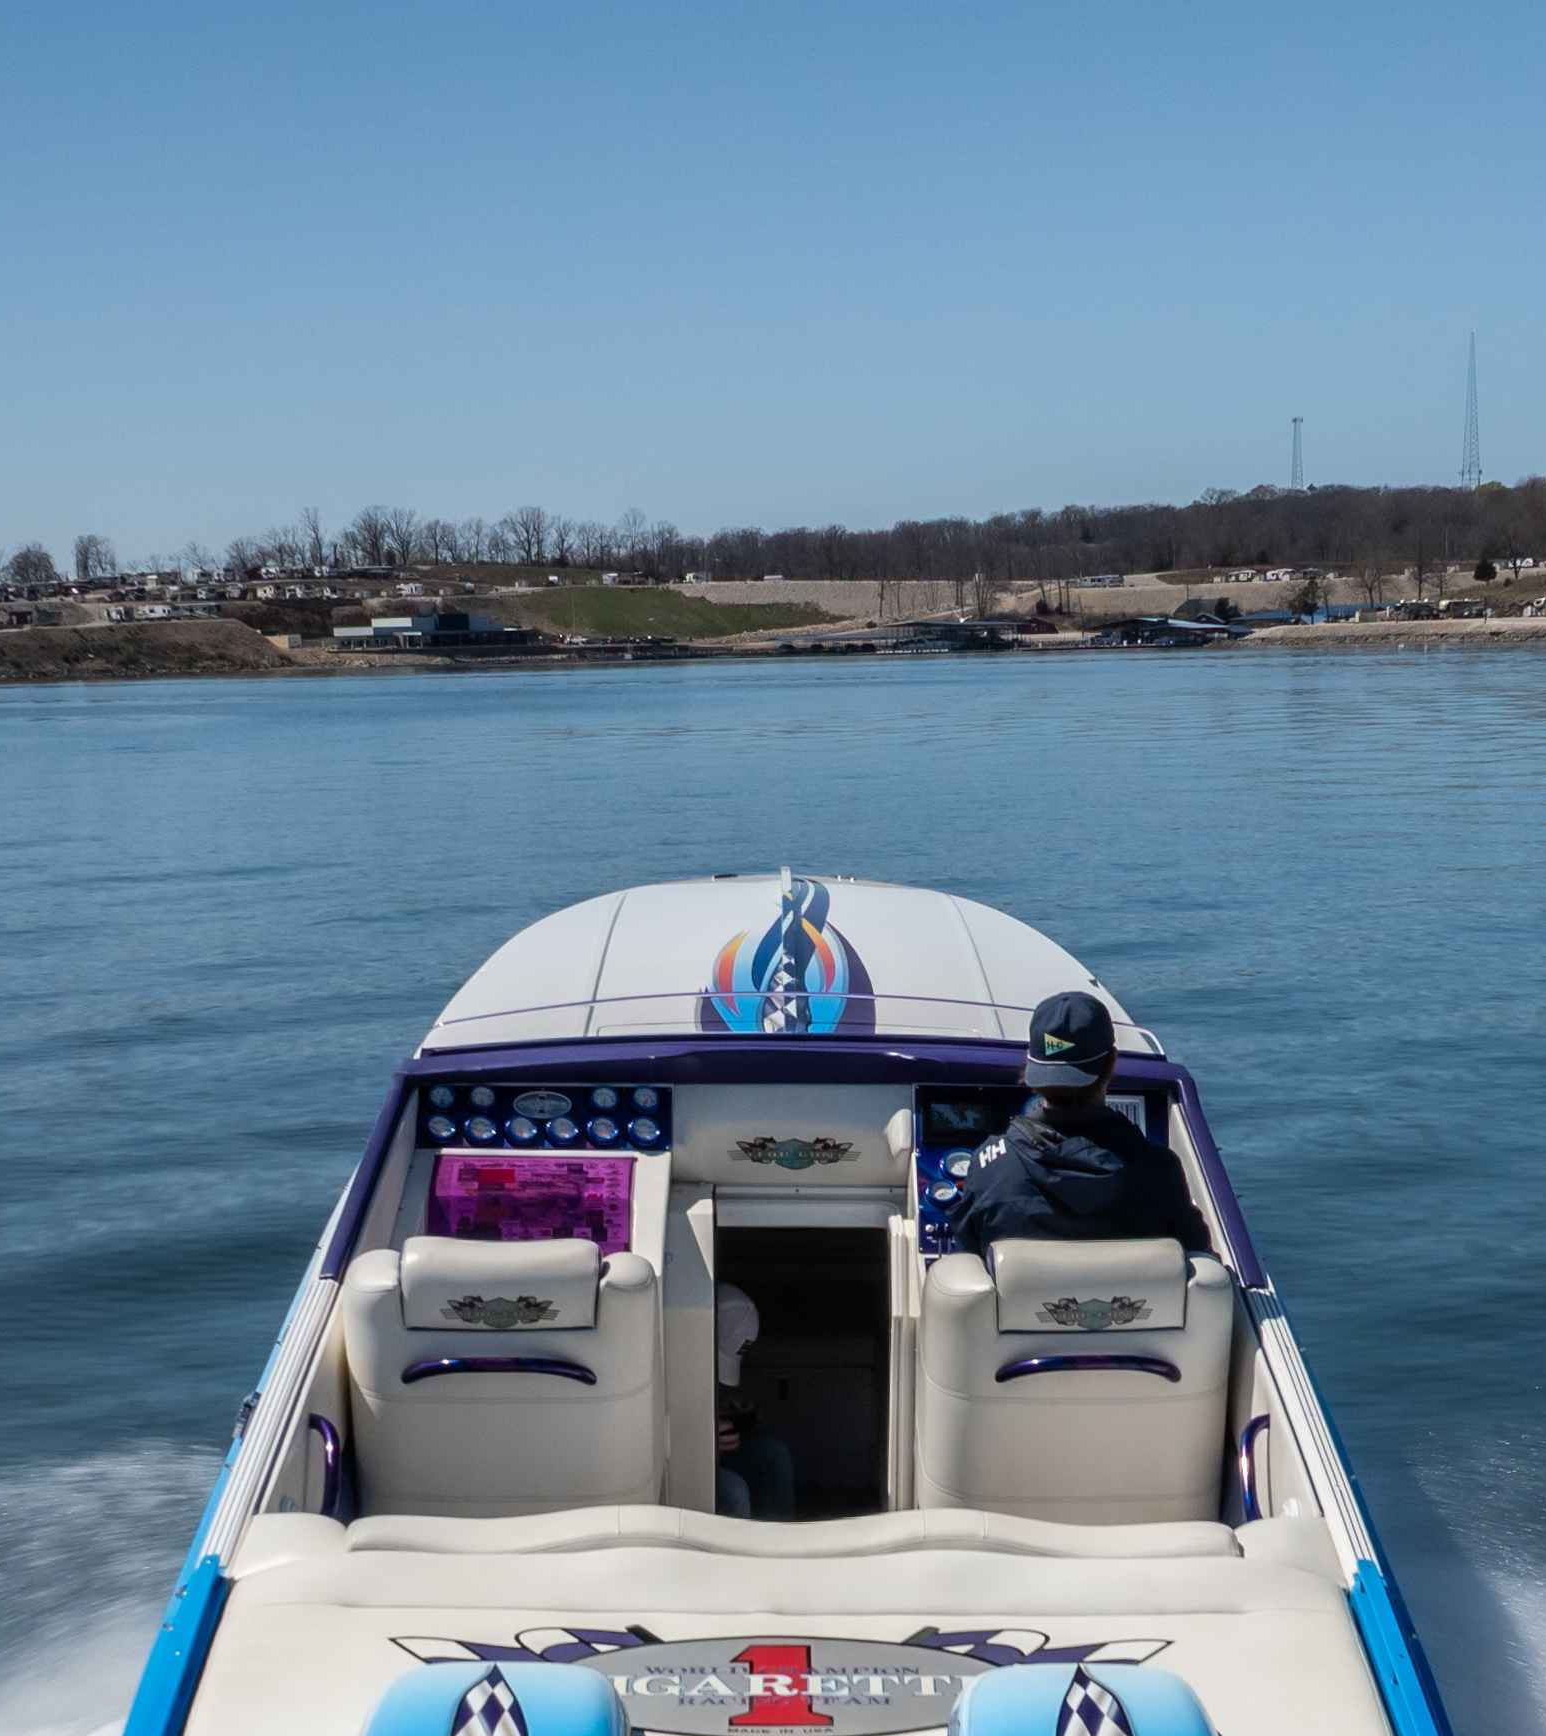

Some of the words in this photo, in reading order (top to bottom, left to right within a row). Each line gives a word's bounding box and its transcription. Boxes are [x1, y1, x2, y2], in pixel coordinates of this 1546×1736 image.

[978, 1137, 1007, 1169] HH
[646, 1666, 749, 1675] WORLD
[758, 1666, 920, 1675] AMPION
[608, 1674, 975, 1696] IGARETT
[729, 1644, 834, 1726] 1
[805, 1696, 892, 1706] EAM
